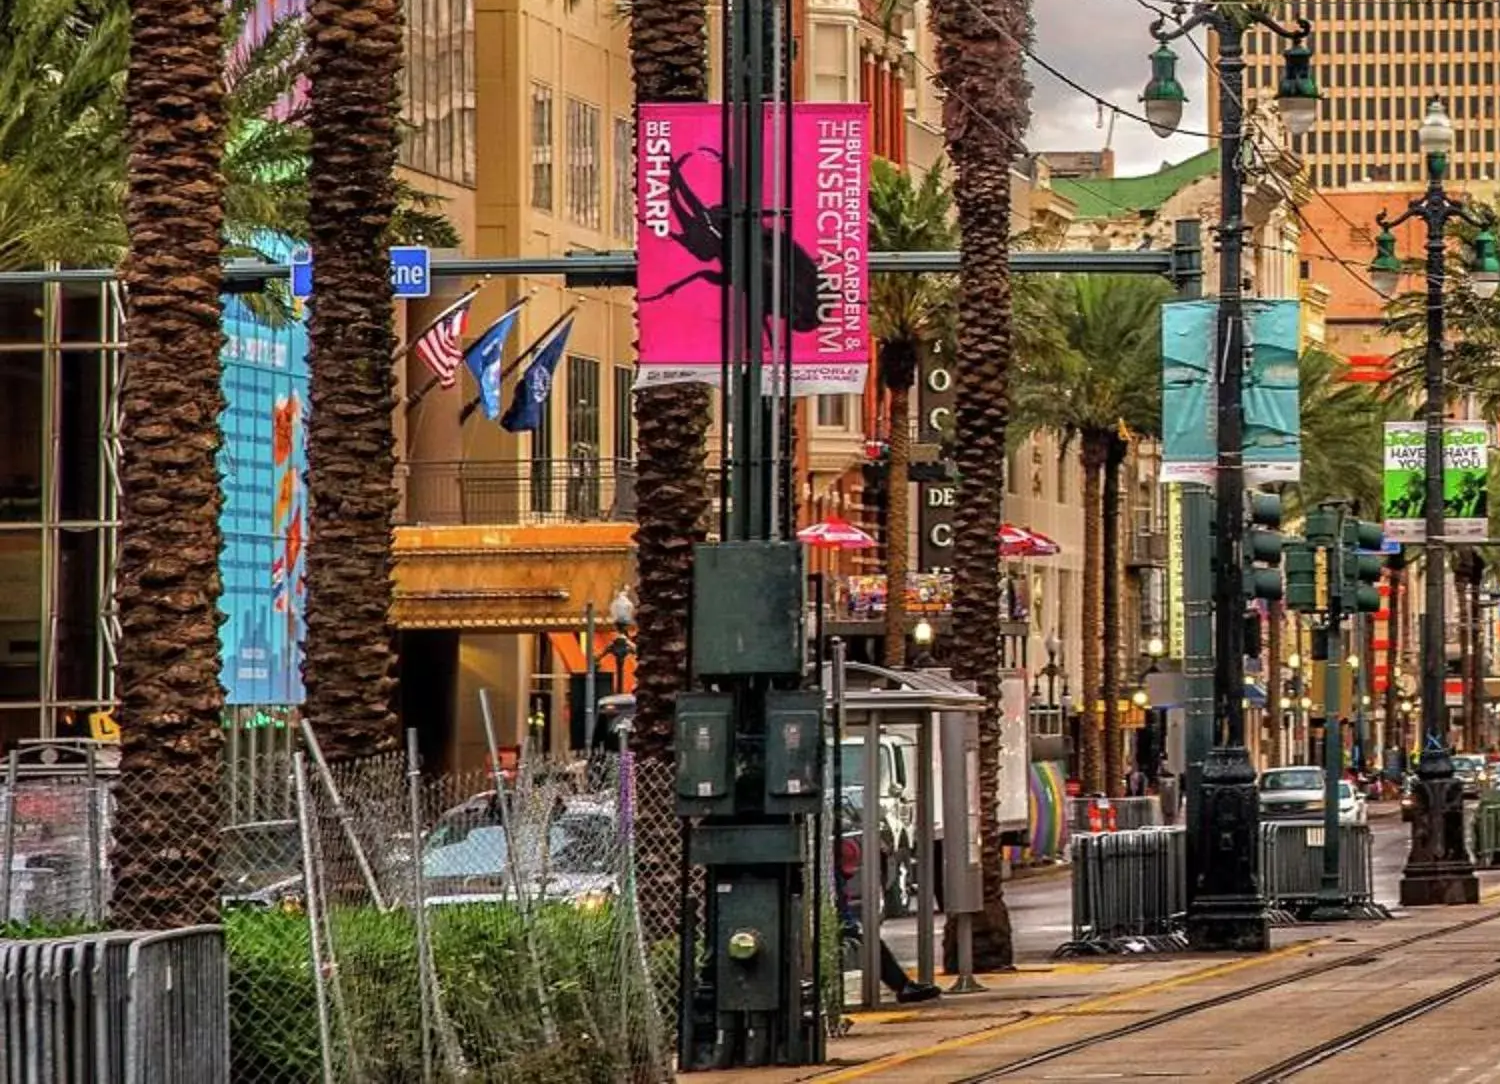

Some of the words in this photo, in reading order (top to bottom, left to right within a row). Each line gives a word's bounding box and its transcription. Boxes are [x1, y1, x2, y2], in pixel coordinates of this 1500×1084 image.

[646, 121, 671, 135] BE
[816, 120, 861, 138] THE
[646, 138, 671, 237] SHARP
[843, 139, 861, 244] BUTTERFLY
[816, 139, 843, 354] INSECTARIUM
[843, 248, 861, 331] GARDEN
